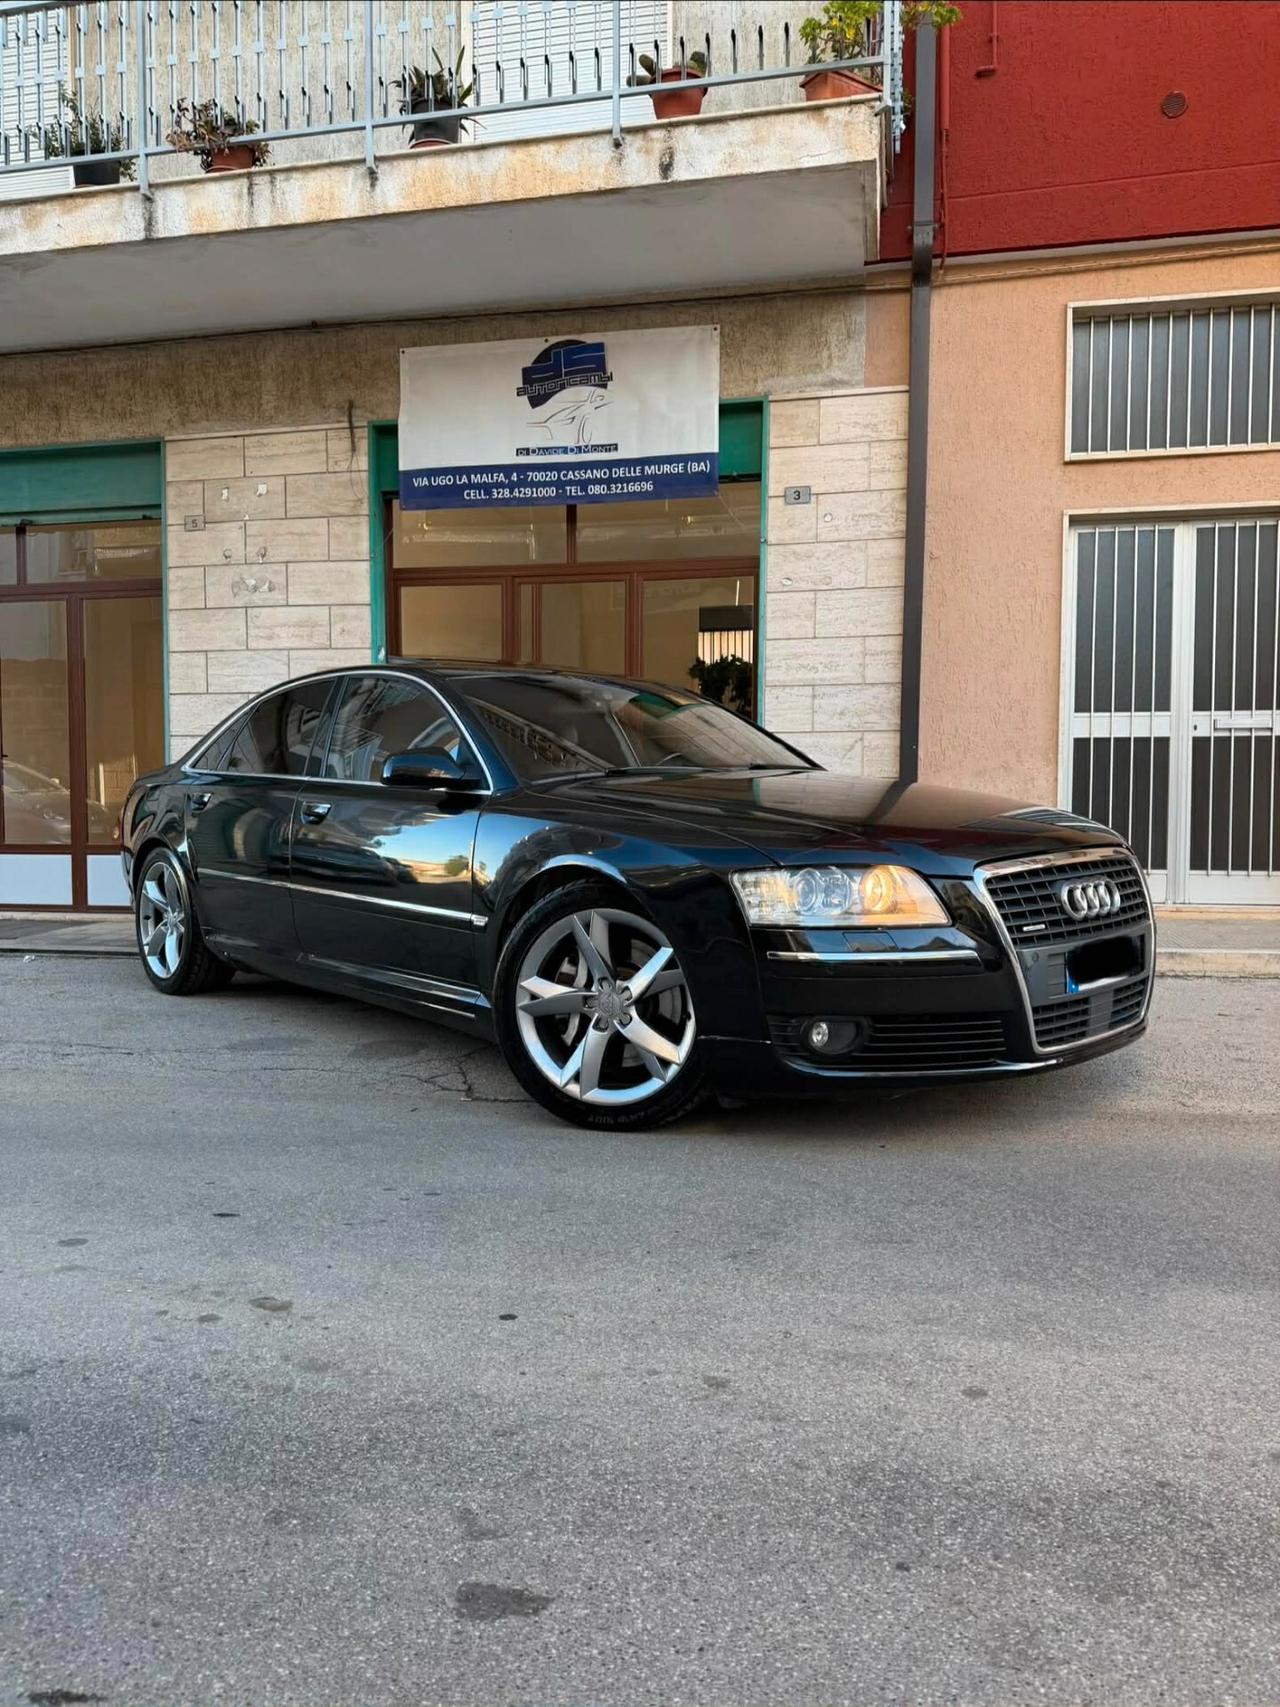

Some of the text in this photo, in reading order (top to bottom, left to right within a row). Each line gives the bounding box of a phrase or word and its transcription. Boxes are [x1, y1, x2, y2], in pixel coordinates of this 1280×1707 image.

[412, 477, 429, 488] VIA
[431, 474, 454, 486] UGO
[456, 474, 469, 485] LA
[470, 472, 509, 485] MALFA,
[510, 472, 517, 482] 4
[526, 470, 558, 482] 70020
[560, 468, 609, 481] CASSANO
[611, 466, 642, 478] DELLE
[644, 462, 684, 475] MURGE
[687, 460, 710, 475] (BA)
[463, 489, 489, 500] CELL.
[491, 486, 556, 499] 328.4291000
[565, 485, 586, 496] TEL.
[587, 481, 654, 495] 080.3216696
[793, 490, 801, 501] 3
[191, 518, 198, 528] 5
